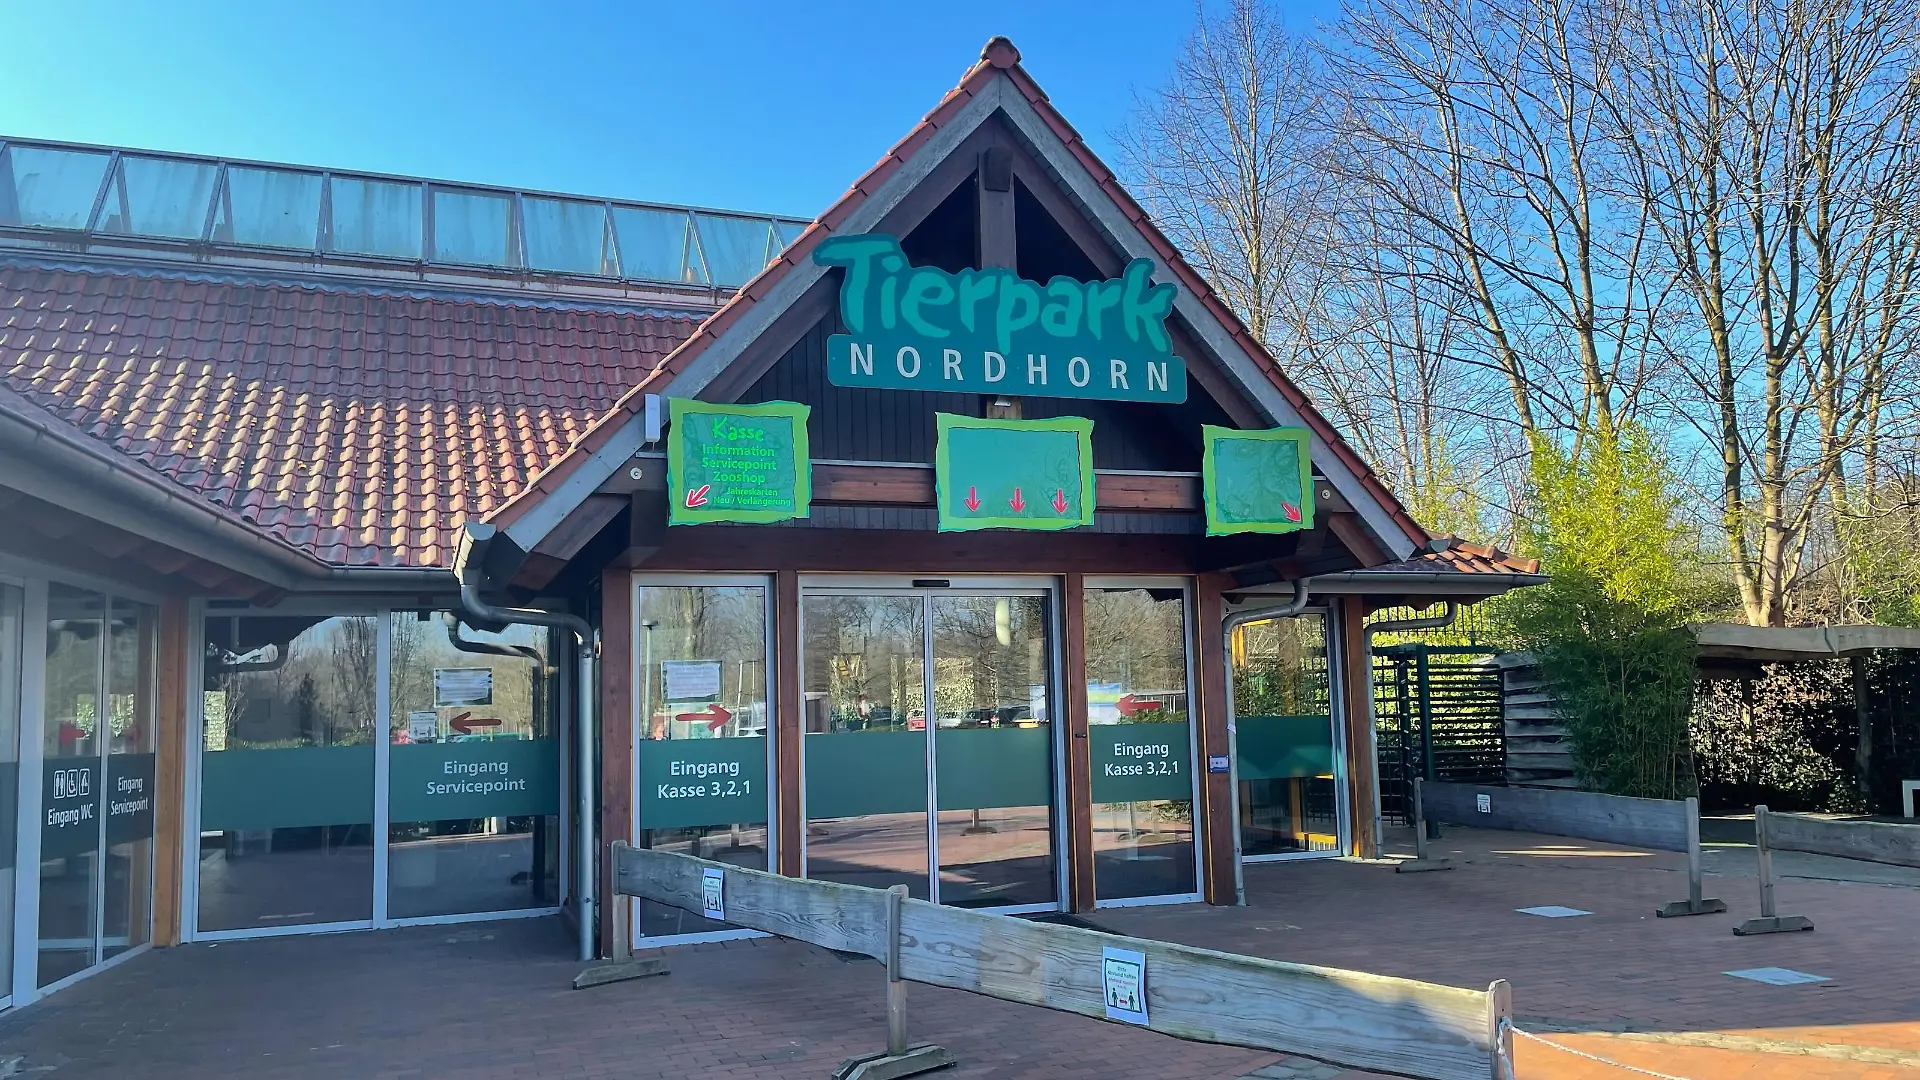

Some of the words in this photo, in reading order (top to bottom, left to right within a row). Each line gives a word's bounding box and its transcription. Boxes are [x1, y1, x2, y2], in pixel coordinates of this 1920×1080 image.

[820, 239, 1172, 356] Tierpark
[850, 342, 1168, 392] NORDHORN
[712, 416, 764, 441] Kasse
[702, 443, 775, 457] Information
[702, 457, 777, 471] Servicepoint
[713, 471, 766, 485] Zooshop
[713, 496, 730, 505] Neu
[726, 486, 778, 497] Jahreskarten
[1114, 742, 1169, 759] Eingang
[444, 760, 509, 776] Eingang
[670, 760, 740, 779] Eingang
[1104, 763, 1143, 776] Kasse
[1146, 760, 1179, 776] 3,2,1
[117, 776, 143, 794] Eingang
[426, 777, 526, 795] Servicepoint
[657, 783, 706, 799] Kasse
[710, 780, 751, 798] 3,2,1
[47, 807, 79, 828] Eingang
[80, 803, 94, 820] WC
[110, 797, 149, 816] Servicepoint
